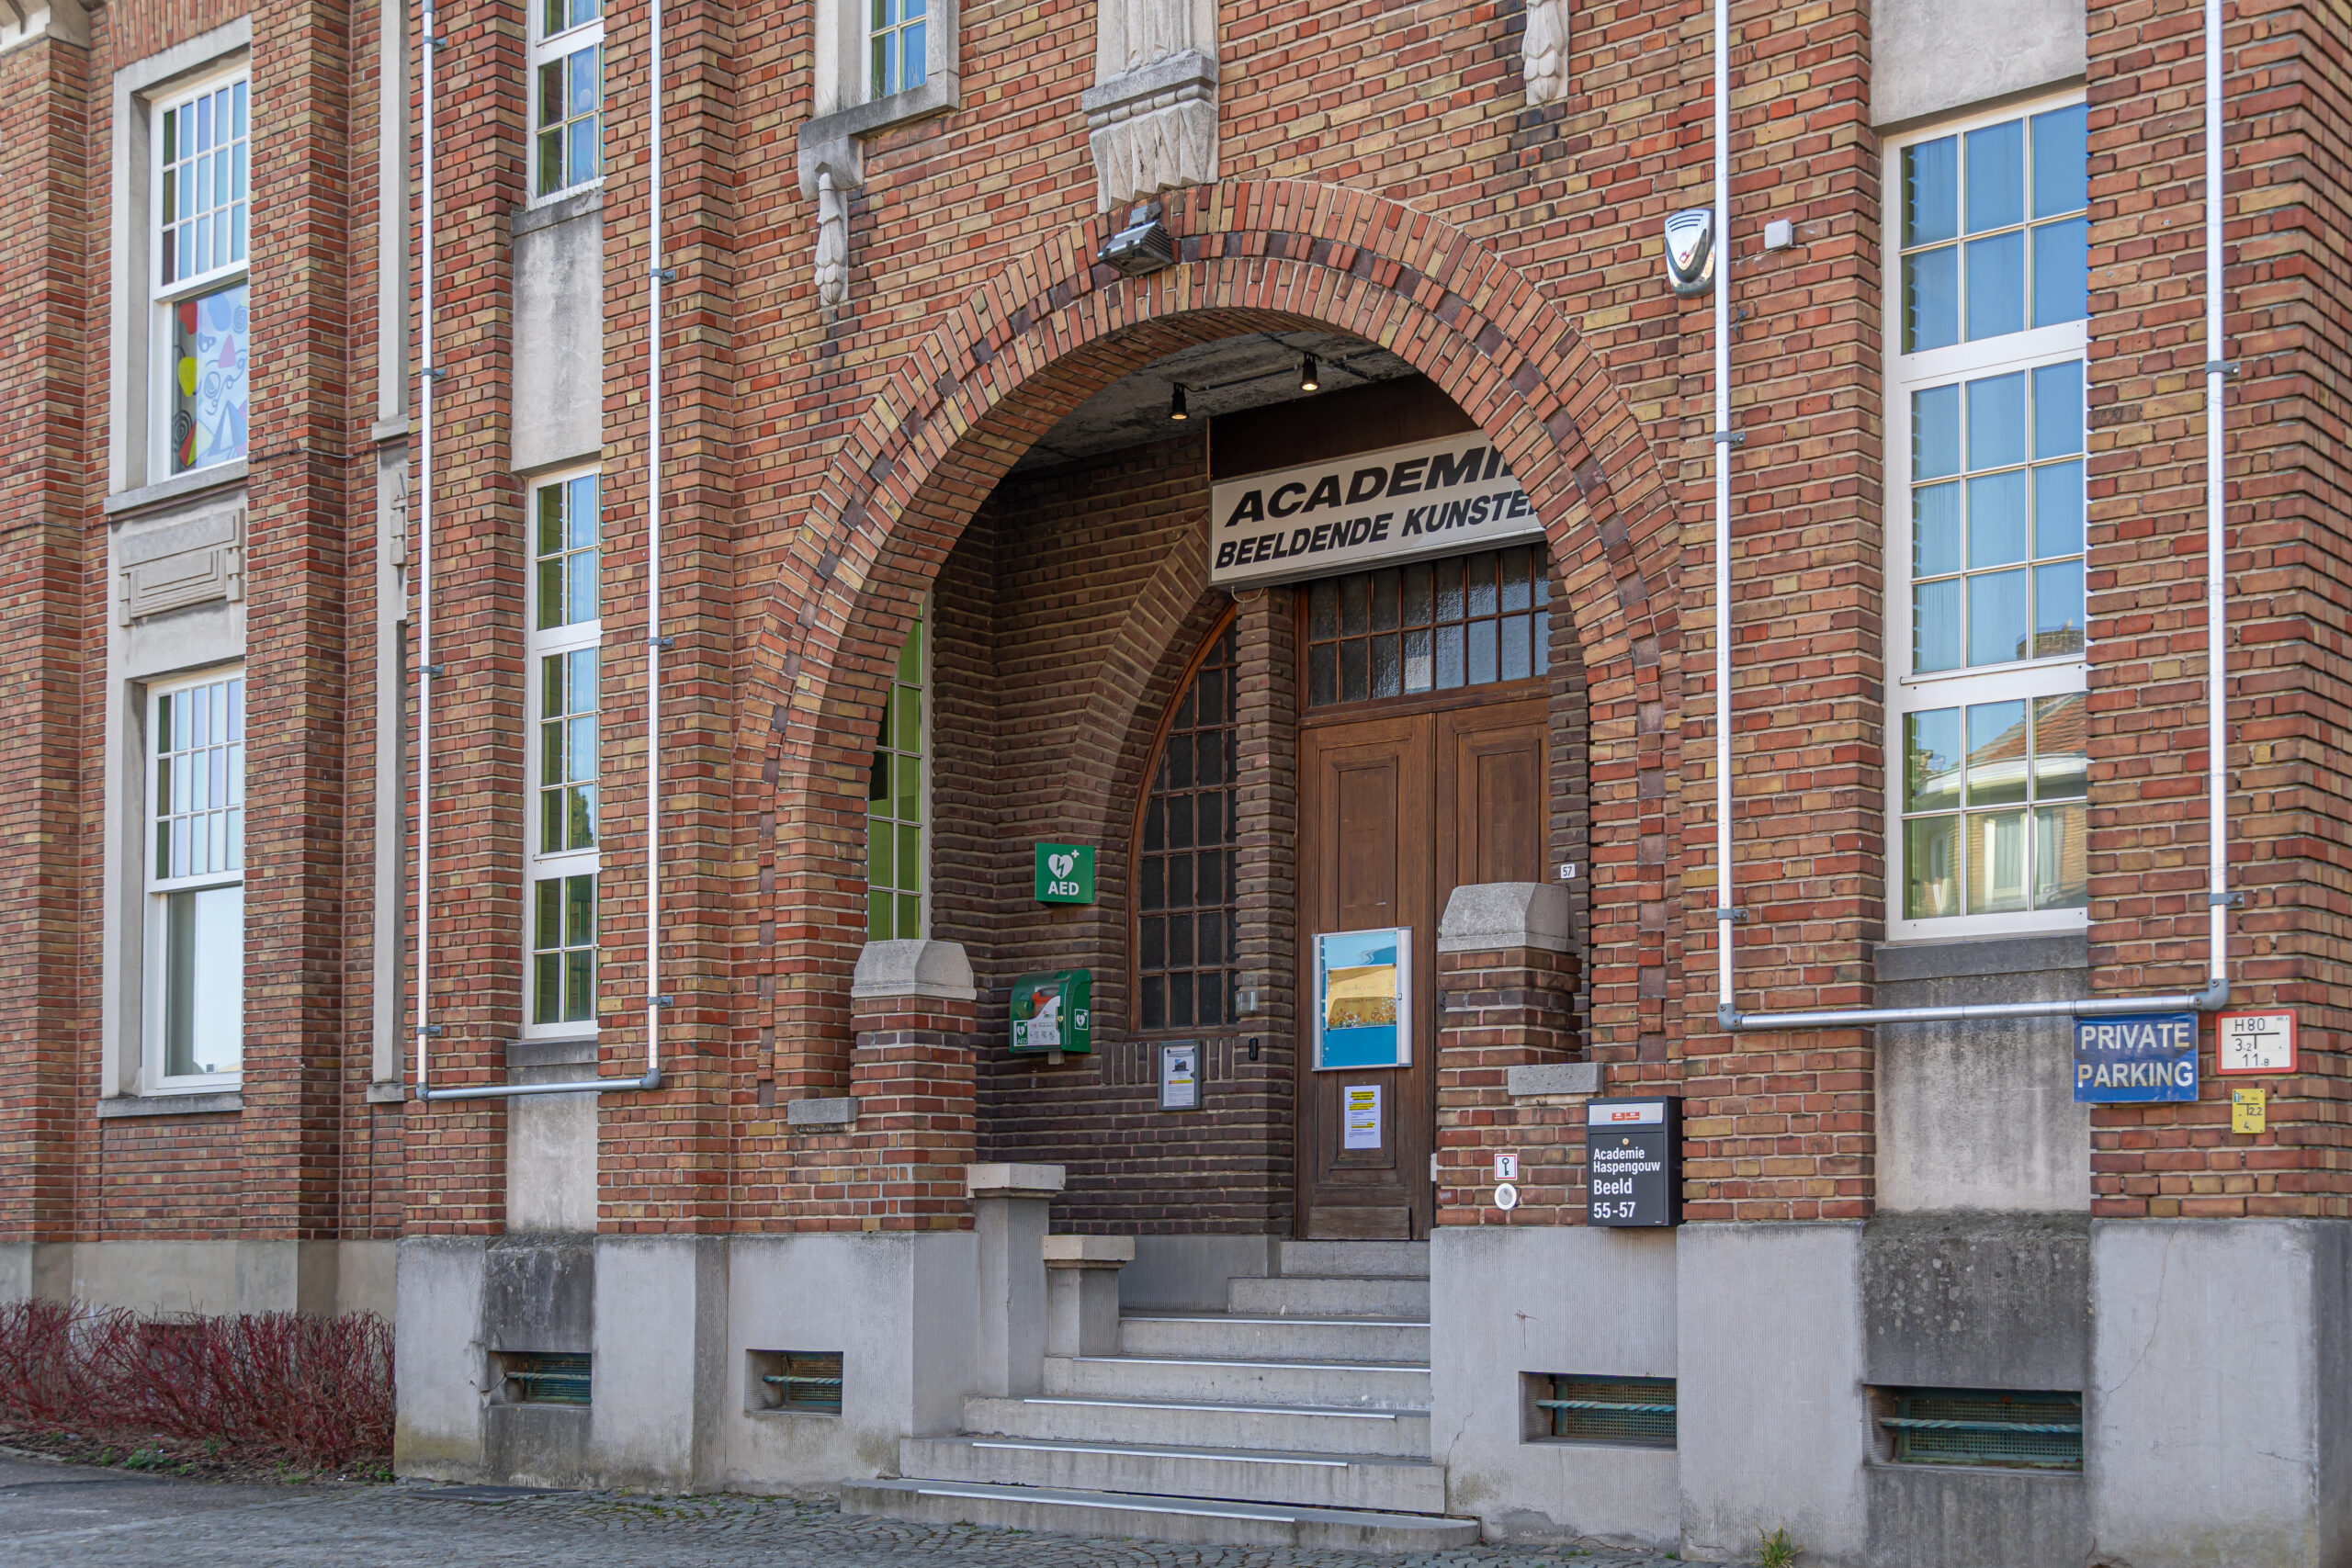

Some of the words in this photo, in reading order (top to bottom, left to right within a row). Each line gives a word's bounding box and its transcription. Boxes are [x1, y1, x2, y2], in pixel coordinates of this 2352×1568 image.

[1225, 446, 1514, 528] ACADEMI
[1215, 513, 1393, 570] BEELDENDE
[1402, 489, 1535, 537] KUNSTE
[1563, 866, 1572, 876] 57
[1047, 881, 1080, 896] AED
[2081, 1022, 2190, 1050] PRIVATE
[2077, 1061, 2193, 1089] PARKING
[1593, 1147, 1645, 1160] Academie
[1593, 1161, 1661, 1175] Haspengouw
[1593, 1179, 1633, 1195] Beeld
[1593, 1201, 1636, 1219] 55-57
